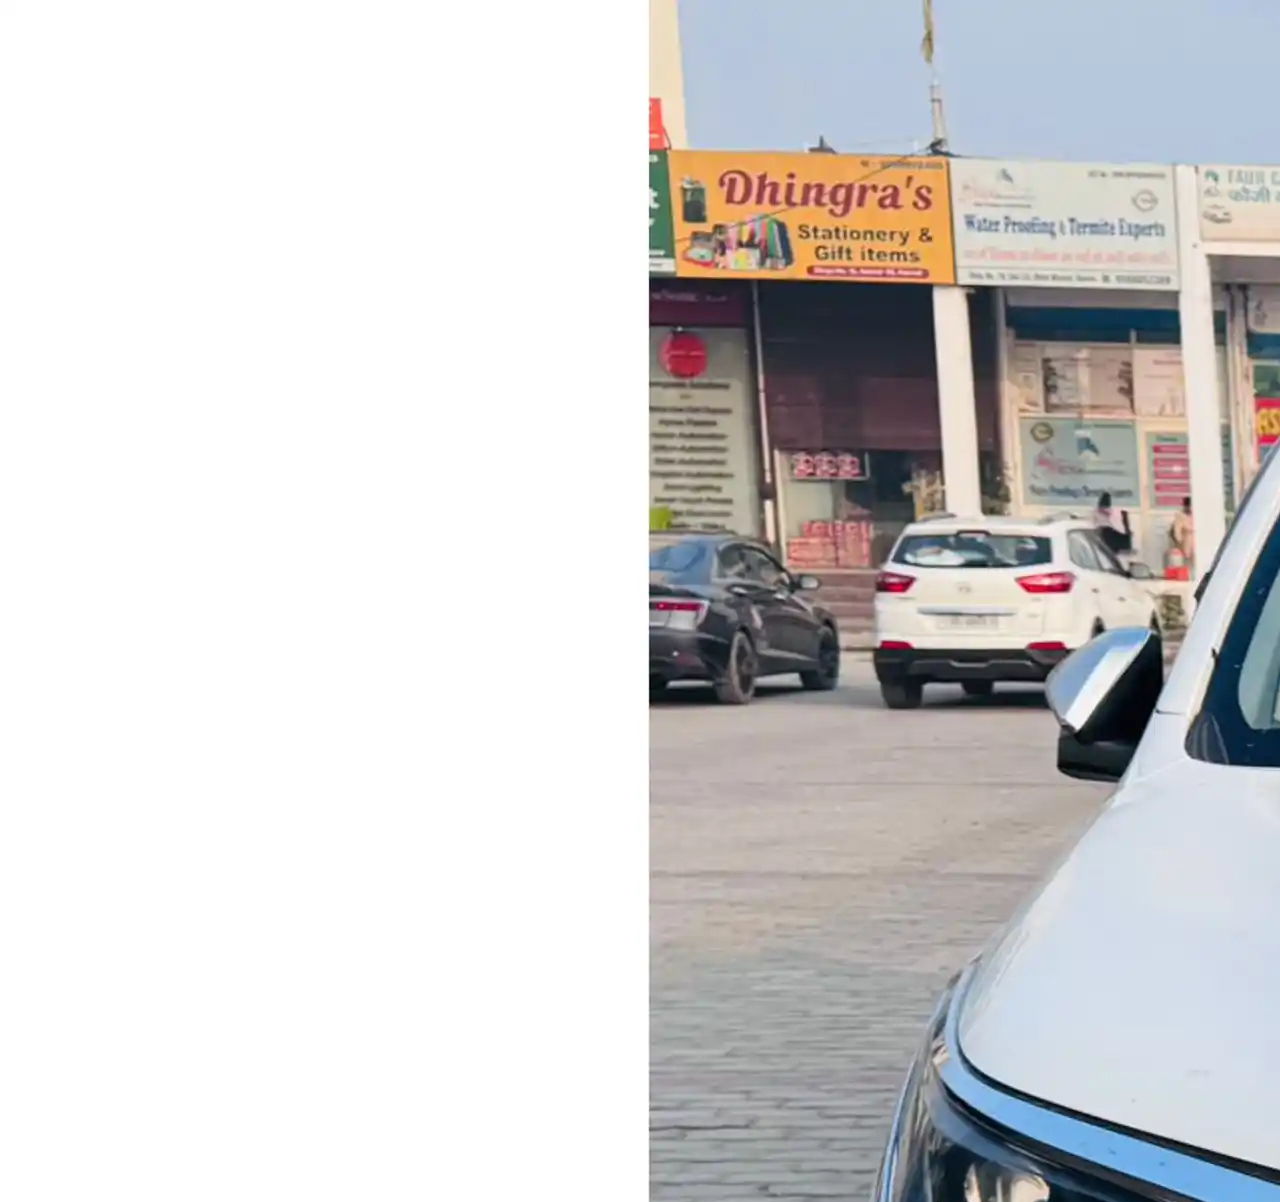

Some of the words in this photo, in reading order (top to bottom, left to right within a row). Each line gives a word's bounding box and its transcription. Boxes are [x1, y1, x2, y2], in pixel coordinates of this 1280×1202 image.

[719, 169, 932, 217] Dhingra's
[798, 224, 910, 244] Stationery
[919, 228, 933, 242] &
[964, 214, 1000, 232] Water
[1004, 215, 1057, 239] Proofing
[1068, 217, 1116, 237] Termite
[1119, 218, 1166, 240] Experts
[815, 245, 854, 262] Gift
[860, 247, 921, 262] items
